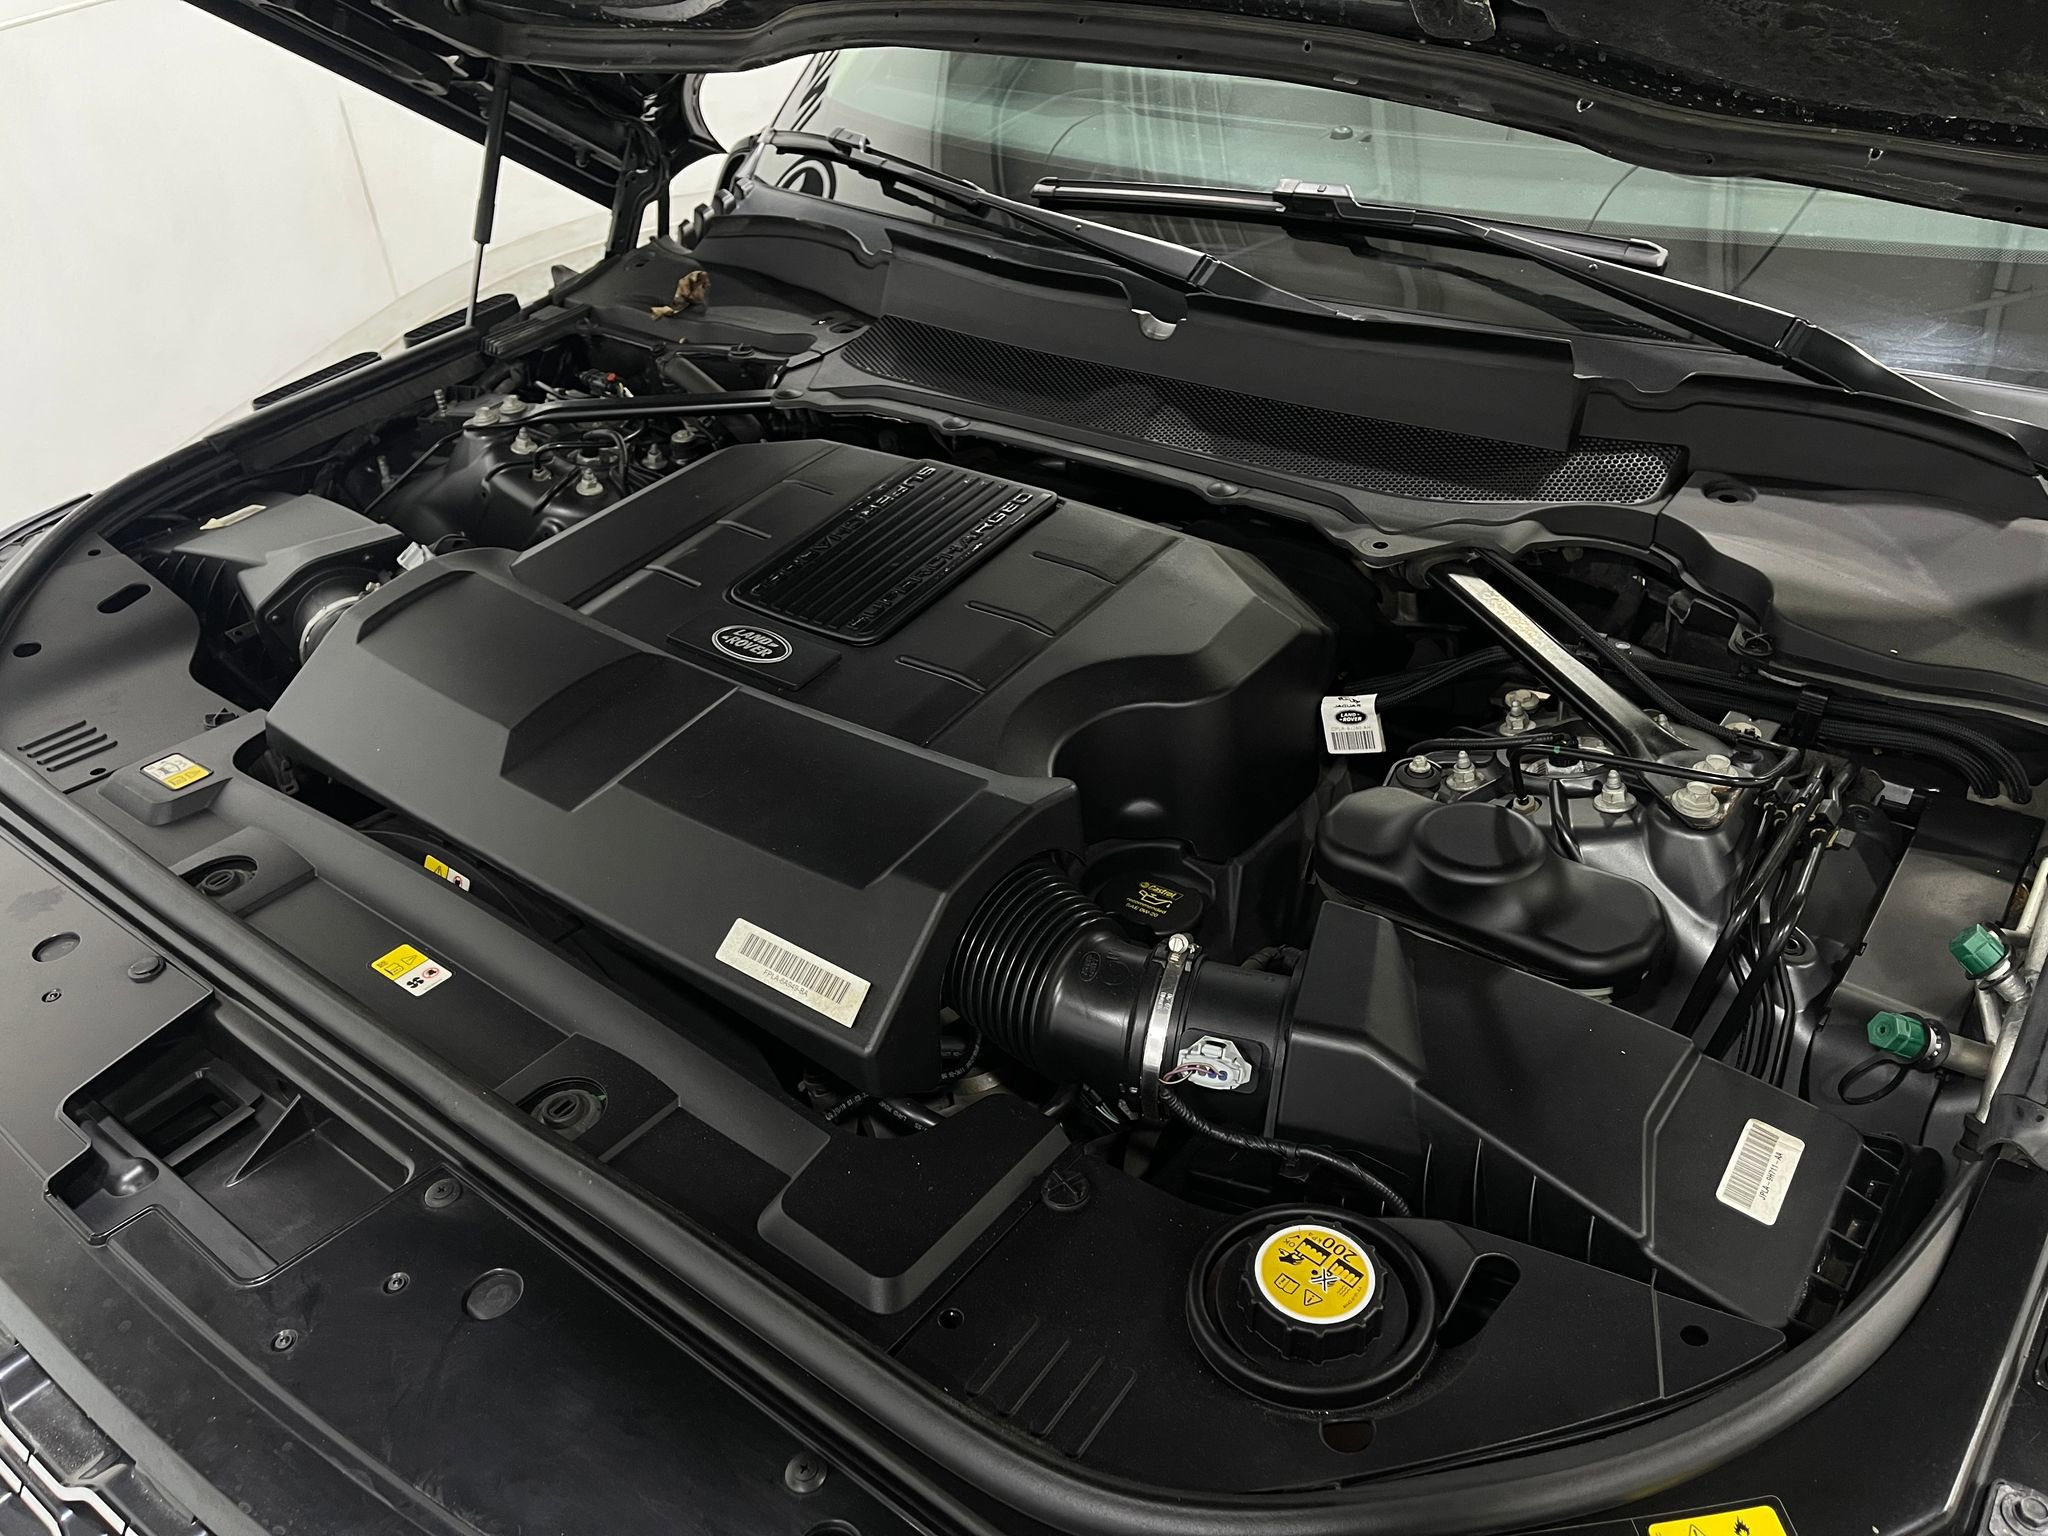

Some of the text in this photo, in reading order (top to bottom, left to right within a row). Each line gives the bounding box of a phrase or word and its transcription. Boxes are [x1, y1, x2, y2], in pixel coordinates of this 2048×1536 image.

[850, 492, 1034, 628] SUPERCHARGED
[725, 635, 773, 657] ROVER
[733, 629, 773, 645] LAND
[1148, 884, 1177, 899] Castrol
[1283, 1237, 1296, 1248] OK
[1321, 1237, 1358, 1263] 200
